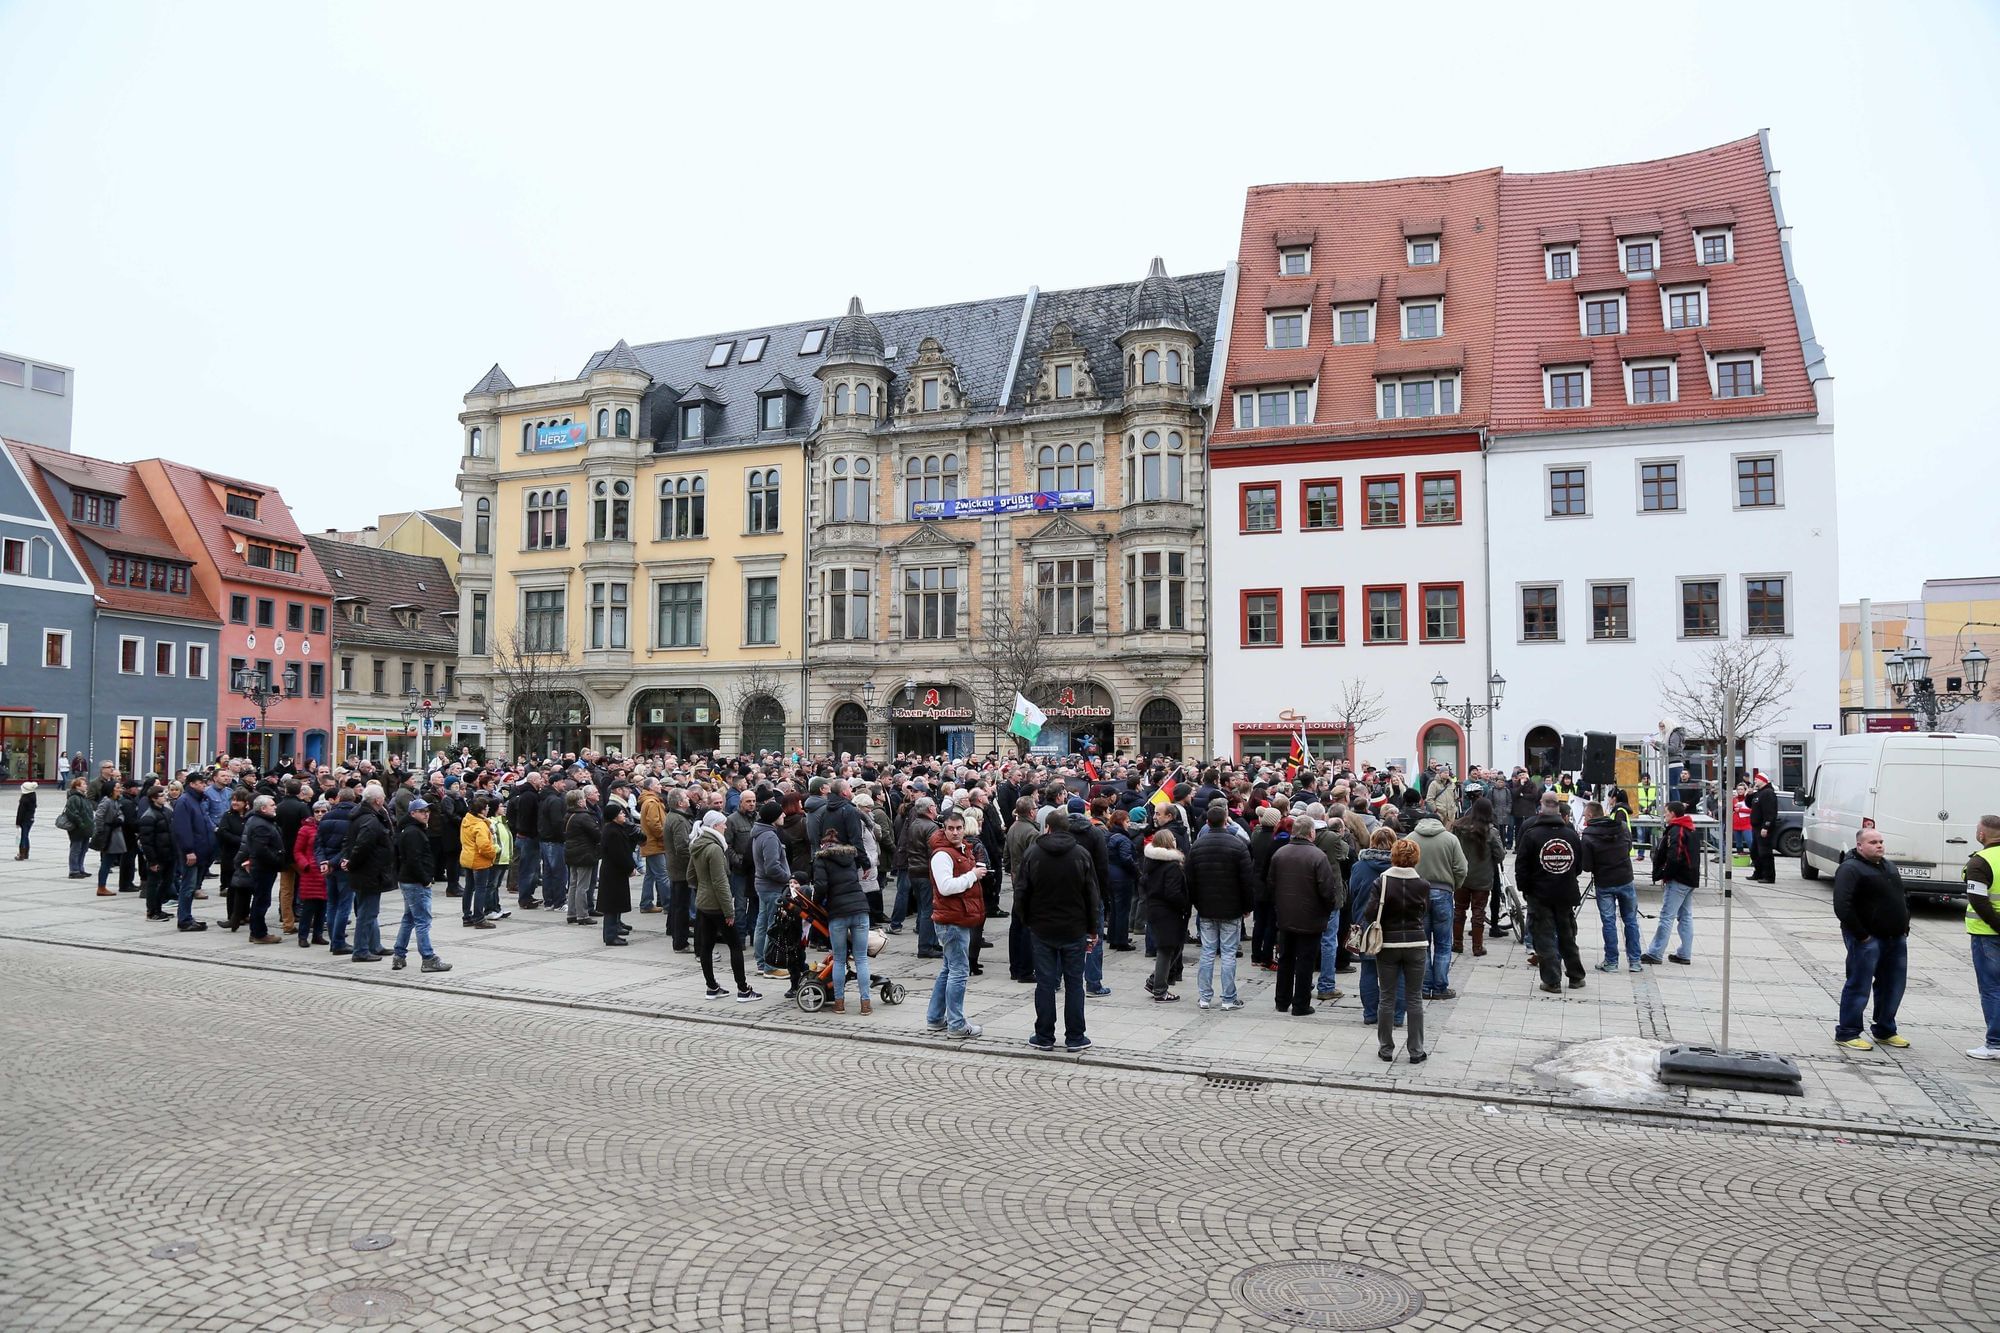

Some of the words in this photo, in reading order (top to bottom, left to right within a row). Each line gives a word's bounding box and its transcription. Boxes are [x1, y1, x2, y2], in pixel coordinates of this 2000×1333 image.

[540, 434, 567, 446] HERZ
[955, 499, 994, 510] Zwickau
[1000, 494, 1033, 507] grüßt!
[1238, 722, 1262, 730] CAFÉ
